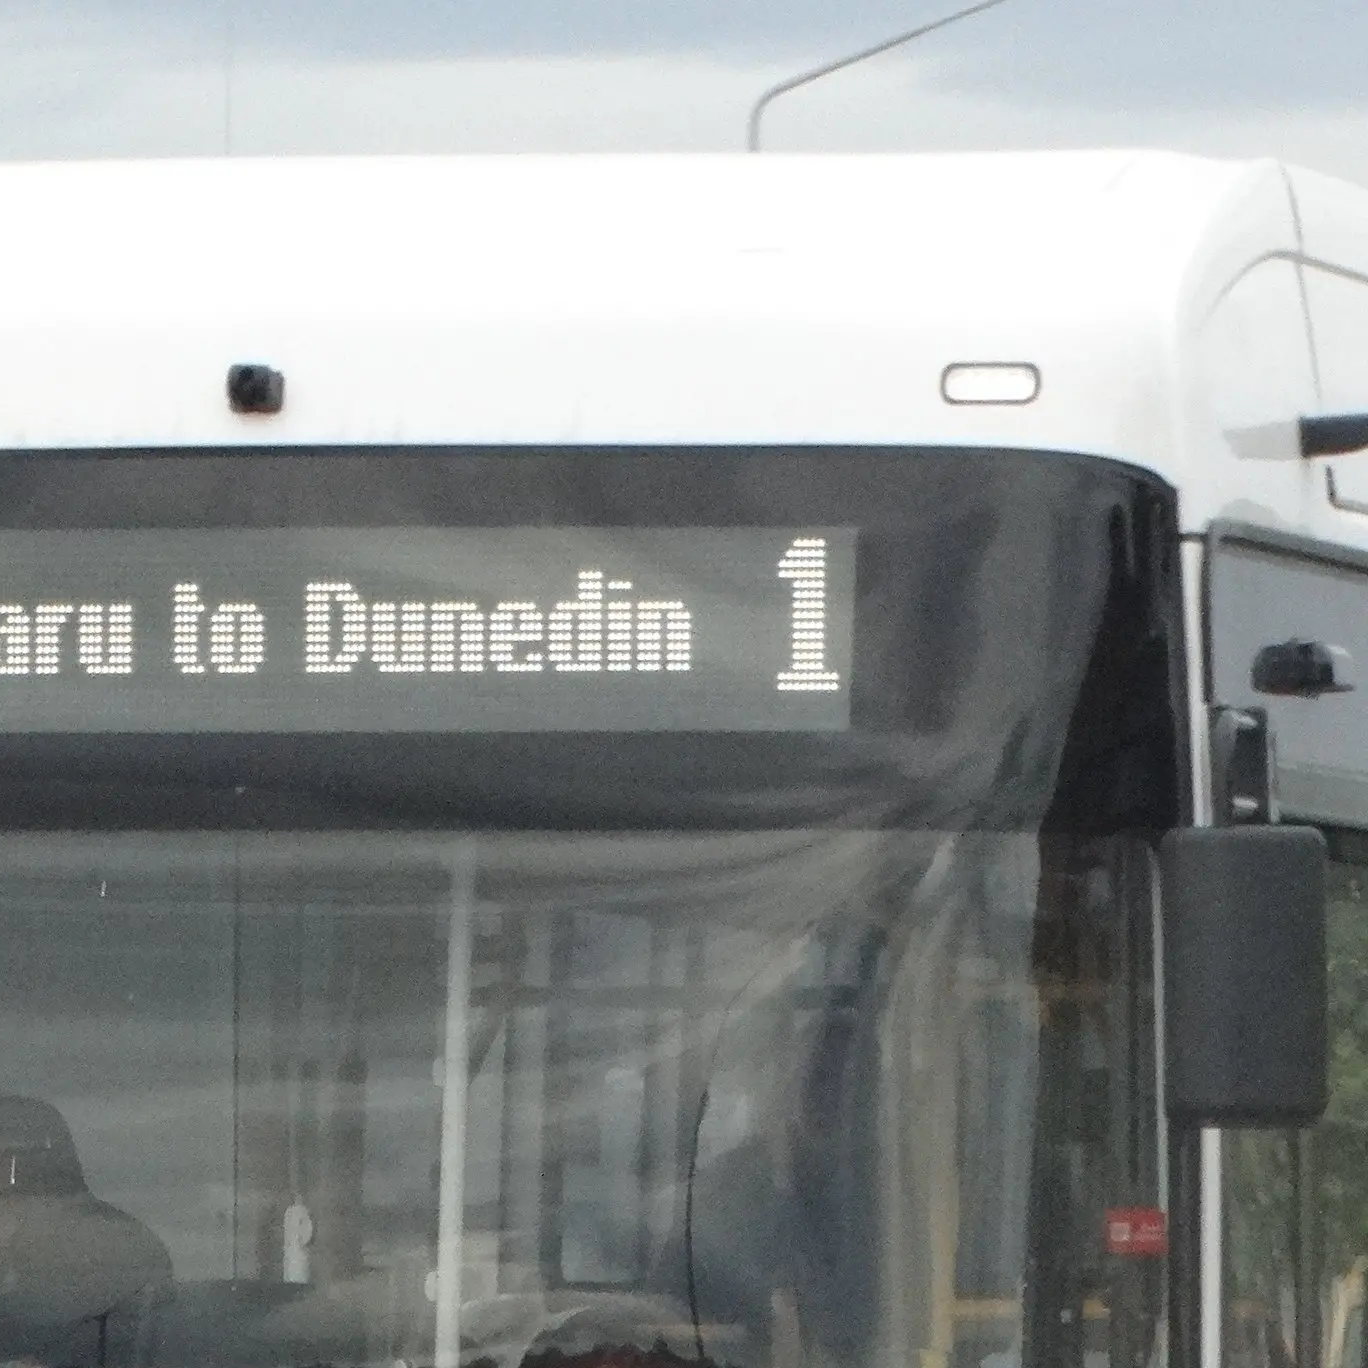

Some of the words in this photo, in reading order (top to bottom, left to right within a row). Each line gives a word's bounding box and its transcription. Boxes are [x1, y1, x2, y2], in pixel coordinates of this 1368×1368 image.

[173, 582, 265, 674] to
[305, 570, 692, 673] Dunedin
[776, 537, 840, 692] 1
